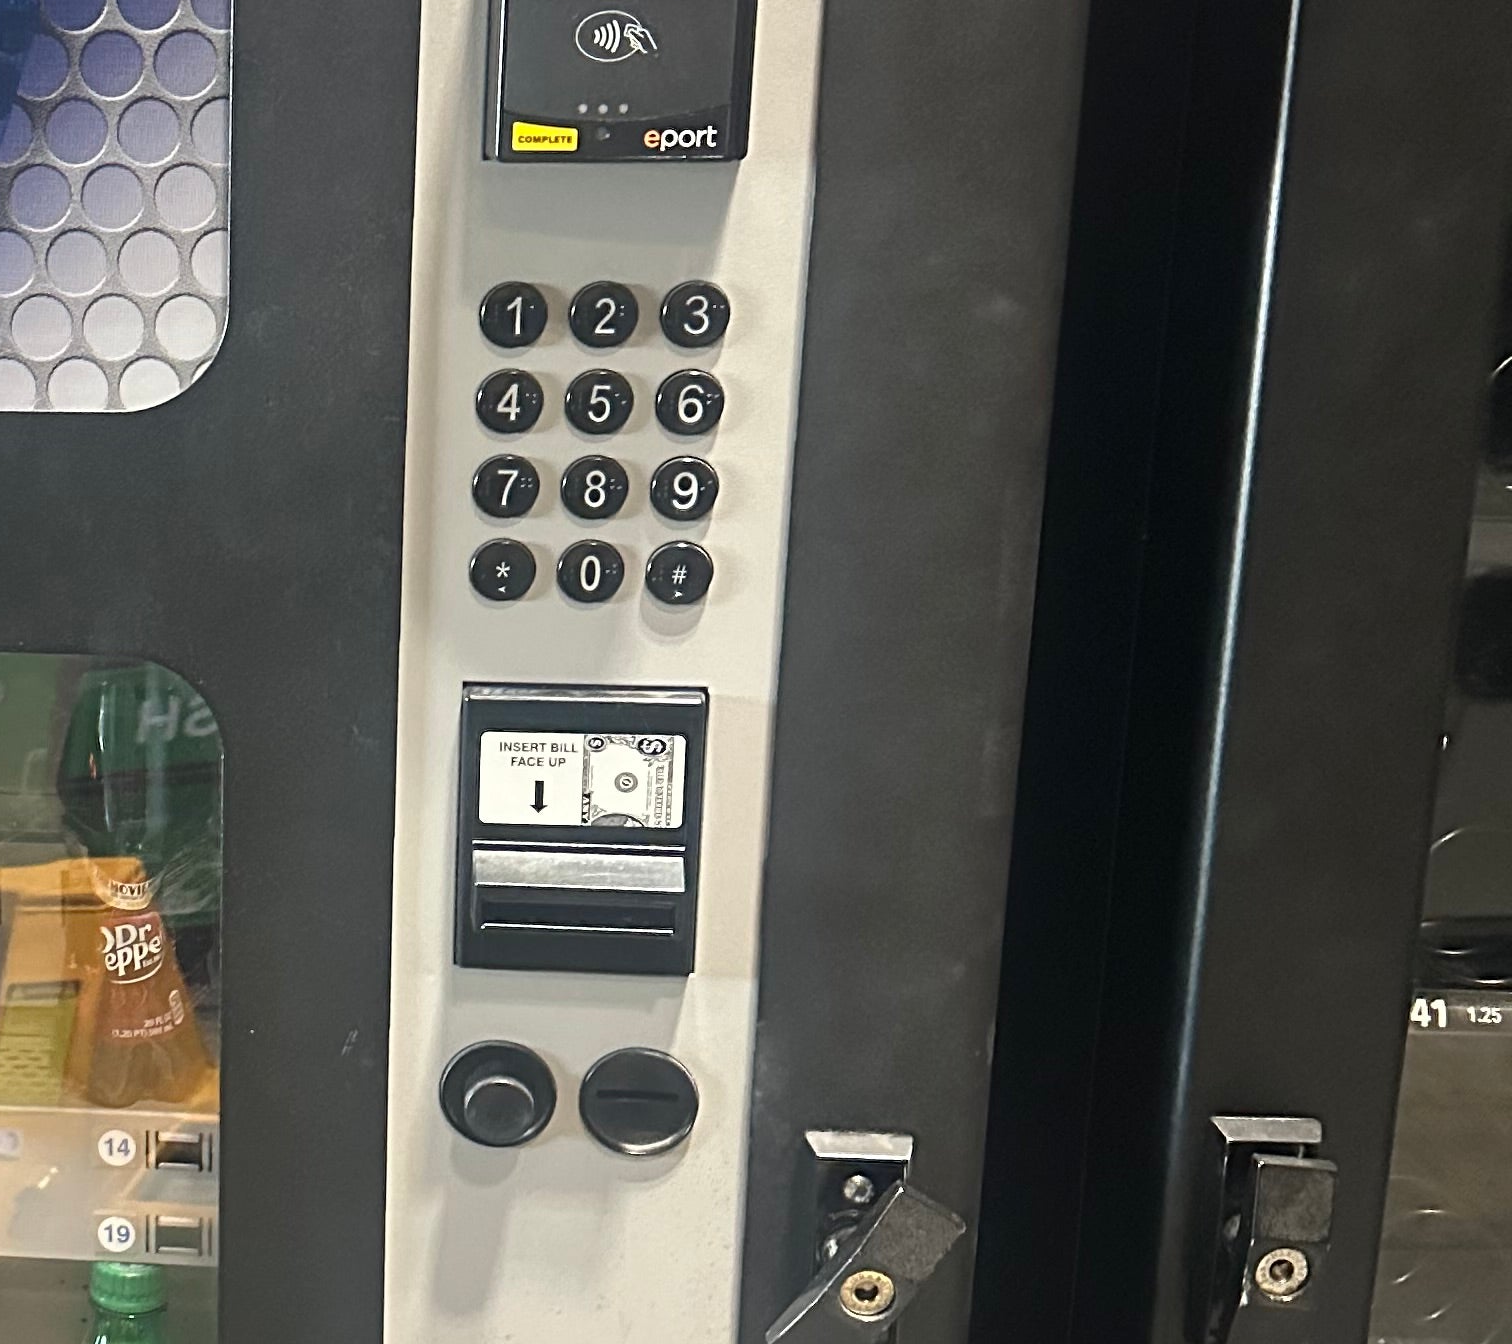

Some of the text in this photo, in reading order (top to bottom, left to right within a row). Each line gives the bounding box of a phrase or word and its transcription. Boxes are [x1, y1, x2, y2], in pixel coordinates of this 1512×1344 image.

[518, 135, 573, 144] COMPLETE
[643, 125, 718, 152] eport
[506, 296, 523, 335] 1
[594, 297, 616, 335] 2
[683, 295, 710, 335] 3
[497, 383, 521, 421] 4
[587, 385, 612, 423] 5
[677, 384, 704, 424] 6
[497, 469, 519, 506] 7
[583, 470, 607, 508] 8
[672, 471, 698, 510] 9
[579, 555, 601, 591] 0
[499, 741, 579, 753] INSERT BILL
[511, 756, 566, 767] FACE UP
[100, 927, 163, 977] eppe
[115, 924, 152, 950] Dr
[1410, 998, 1502, 1028] 41 1.25
[104, 1138, 130, 1157] 14
[105, 1224, 130, 1243] 19
